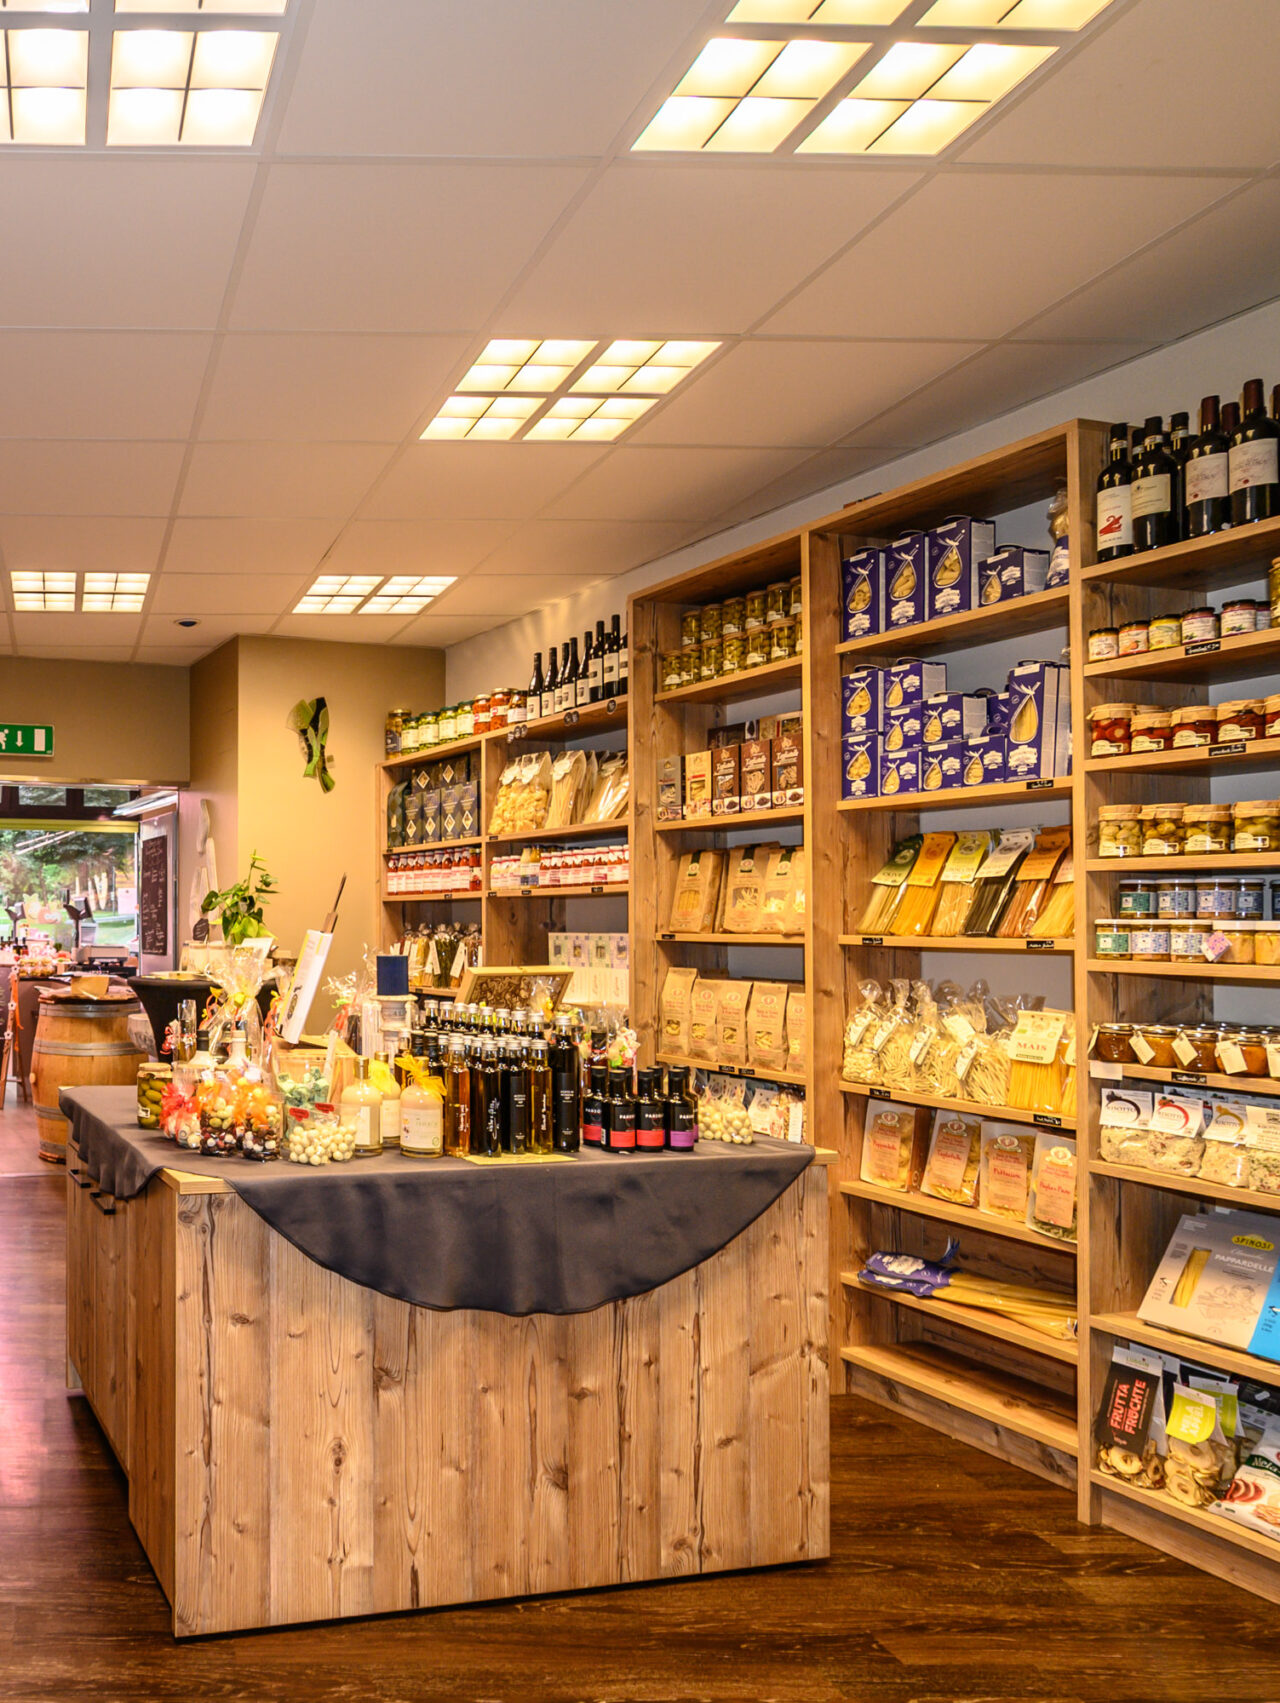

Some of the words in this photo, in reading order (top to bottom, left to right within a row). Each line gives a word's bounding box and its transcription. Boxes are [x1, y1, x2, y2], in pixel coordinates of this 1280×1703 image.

[1235, 1236, 1271, 1250] SPINOSI
[1214, 1254, 1275, 1273] PAPPARDELLE
[1110, 1384, 1130, 1429] FRUTTA
[1125, 1379, 1147, 1435] FRÜCHTE
